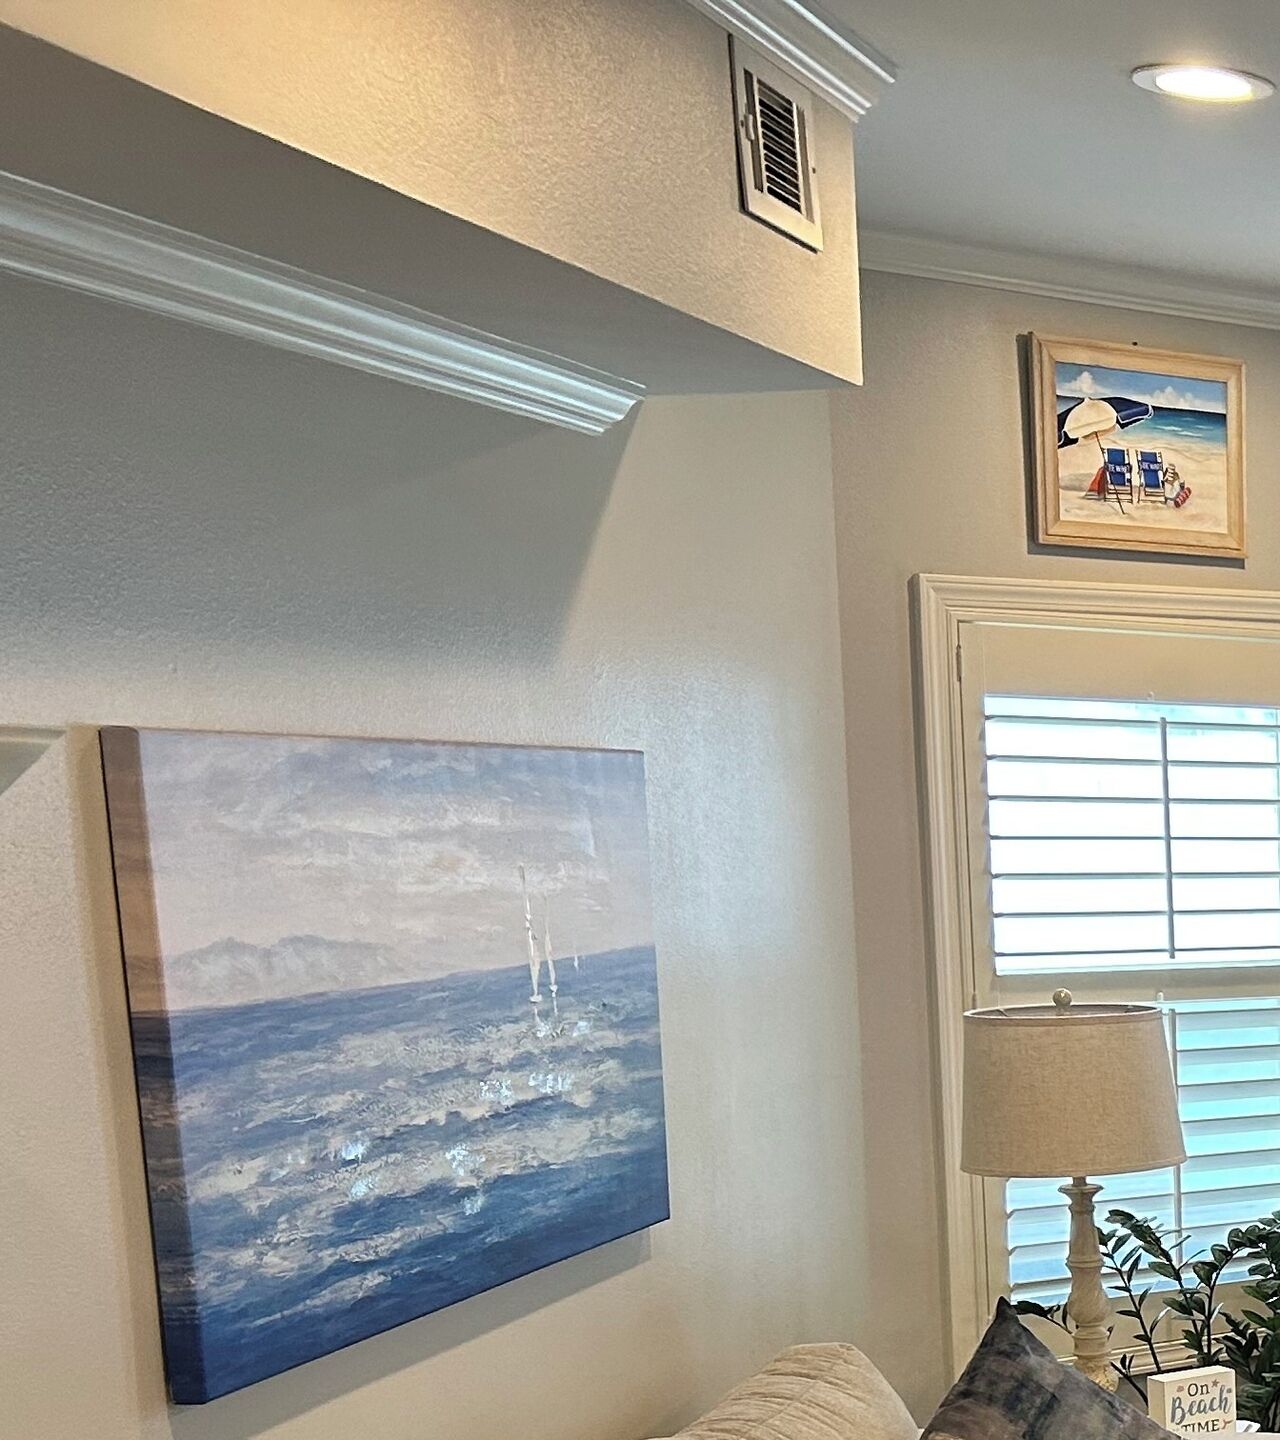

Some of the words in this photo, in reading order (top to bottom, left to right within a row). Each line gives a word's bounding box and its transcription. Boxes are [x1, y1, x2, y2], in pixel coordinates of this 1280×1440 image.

[1187, 1383, 1210, 1397] On
[1170, 1385, 1231, 1426] Beach
[1181, 1419, 1220, 1433] TIME
